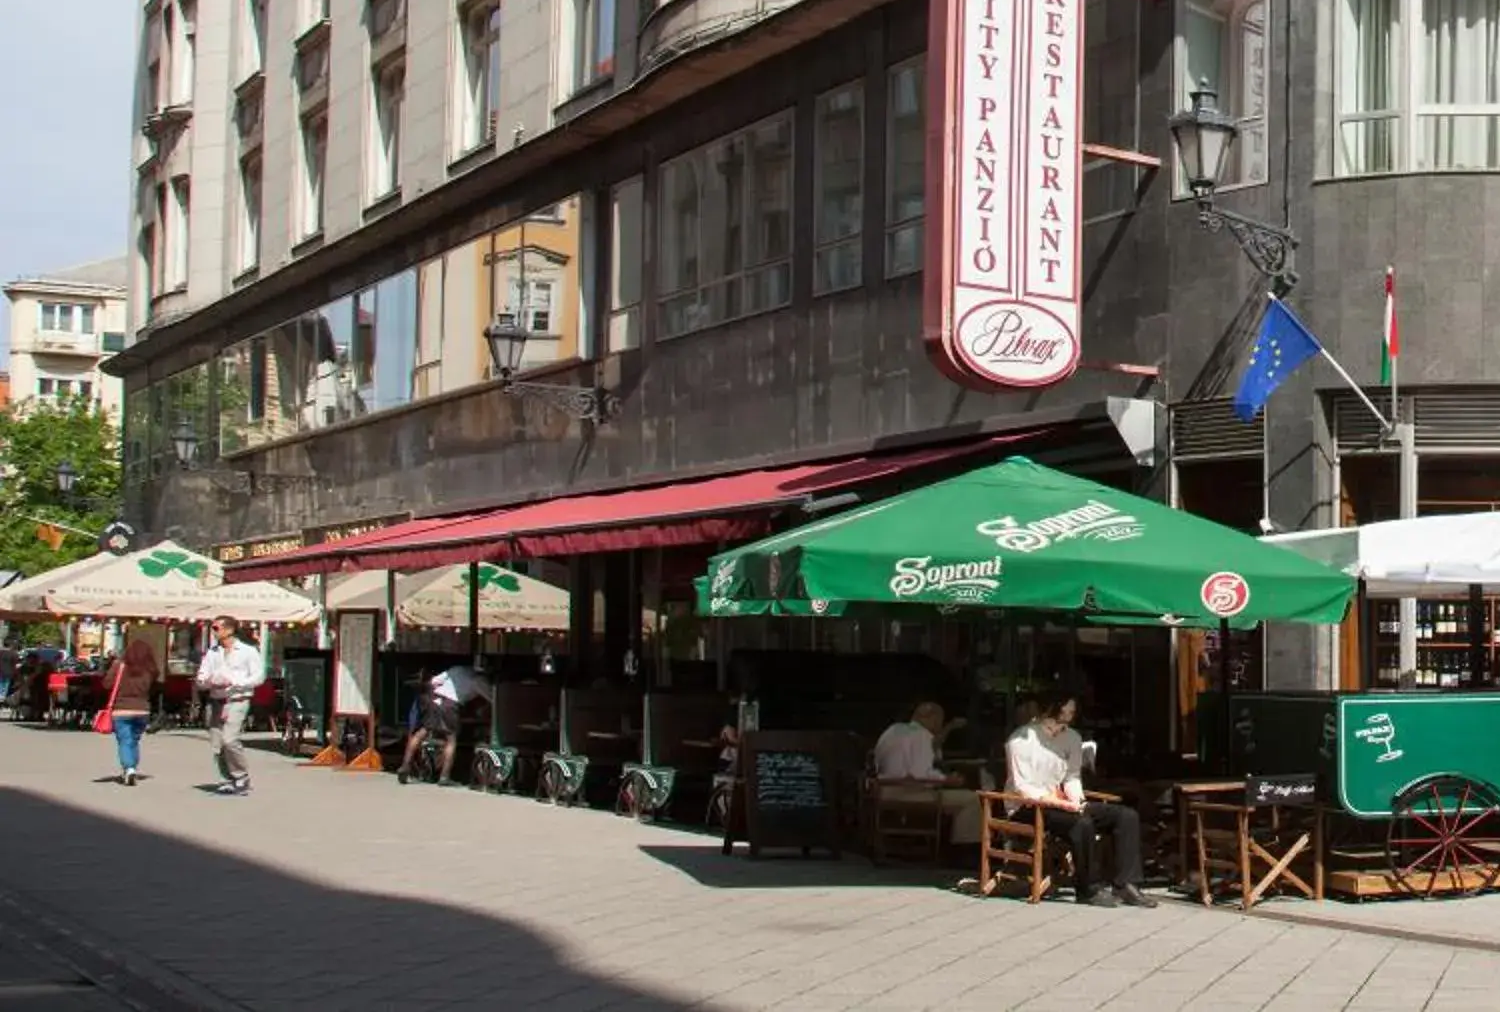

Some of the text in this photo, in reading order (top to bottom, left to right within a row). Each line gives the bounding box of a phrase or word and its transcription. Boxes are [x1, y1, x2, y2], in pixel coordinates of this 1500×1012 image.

[972, 96, 998, 275] PANZIÓ
[971, 309, 1065, 362] Pilvax
[977, 499, 1130, 553] Soproni
[889, 555, 1002, 598] Soproni
